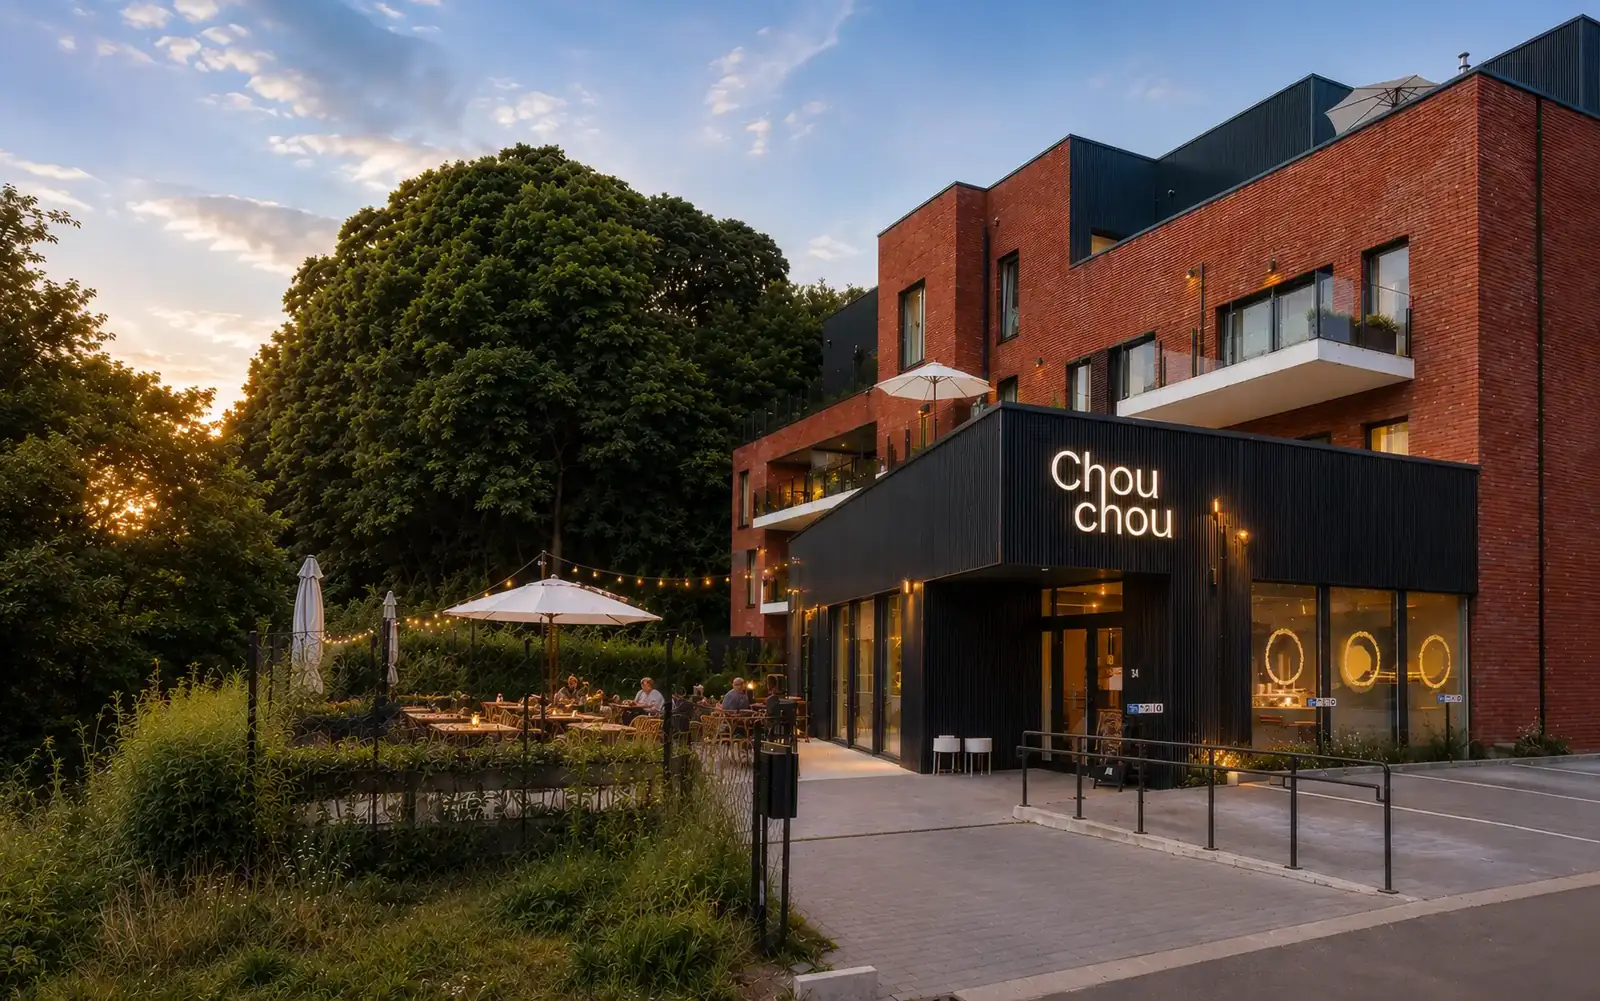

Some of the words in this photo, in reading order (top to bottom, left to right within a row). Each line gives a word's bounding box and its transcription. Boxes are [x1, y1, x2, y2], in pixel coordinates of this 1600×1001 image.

[1051, 450, 1159, 499] Chou
[1074, 500, 1172, 538] chou
[1130, 668, 1139, 678] 34
